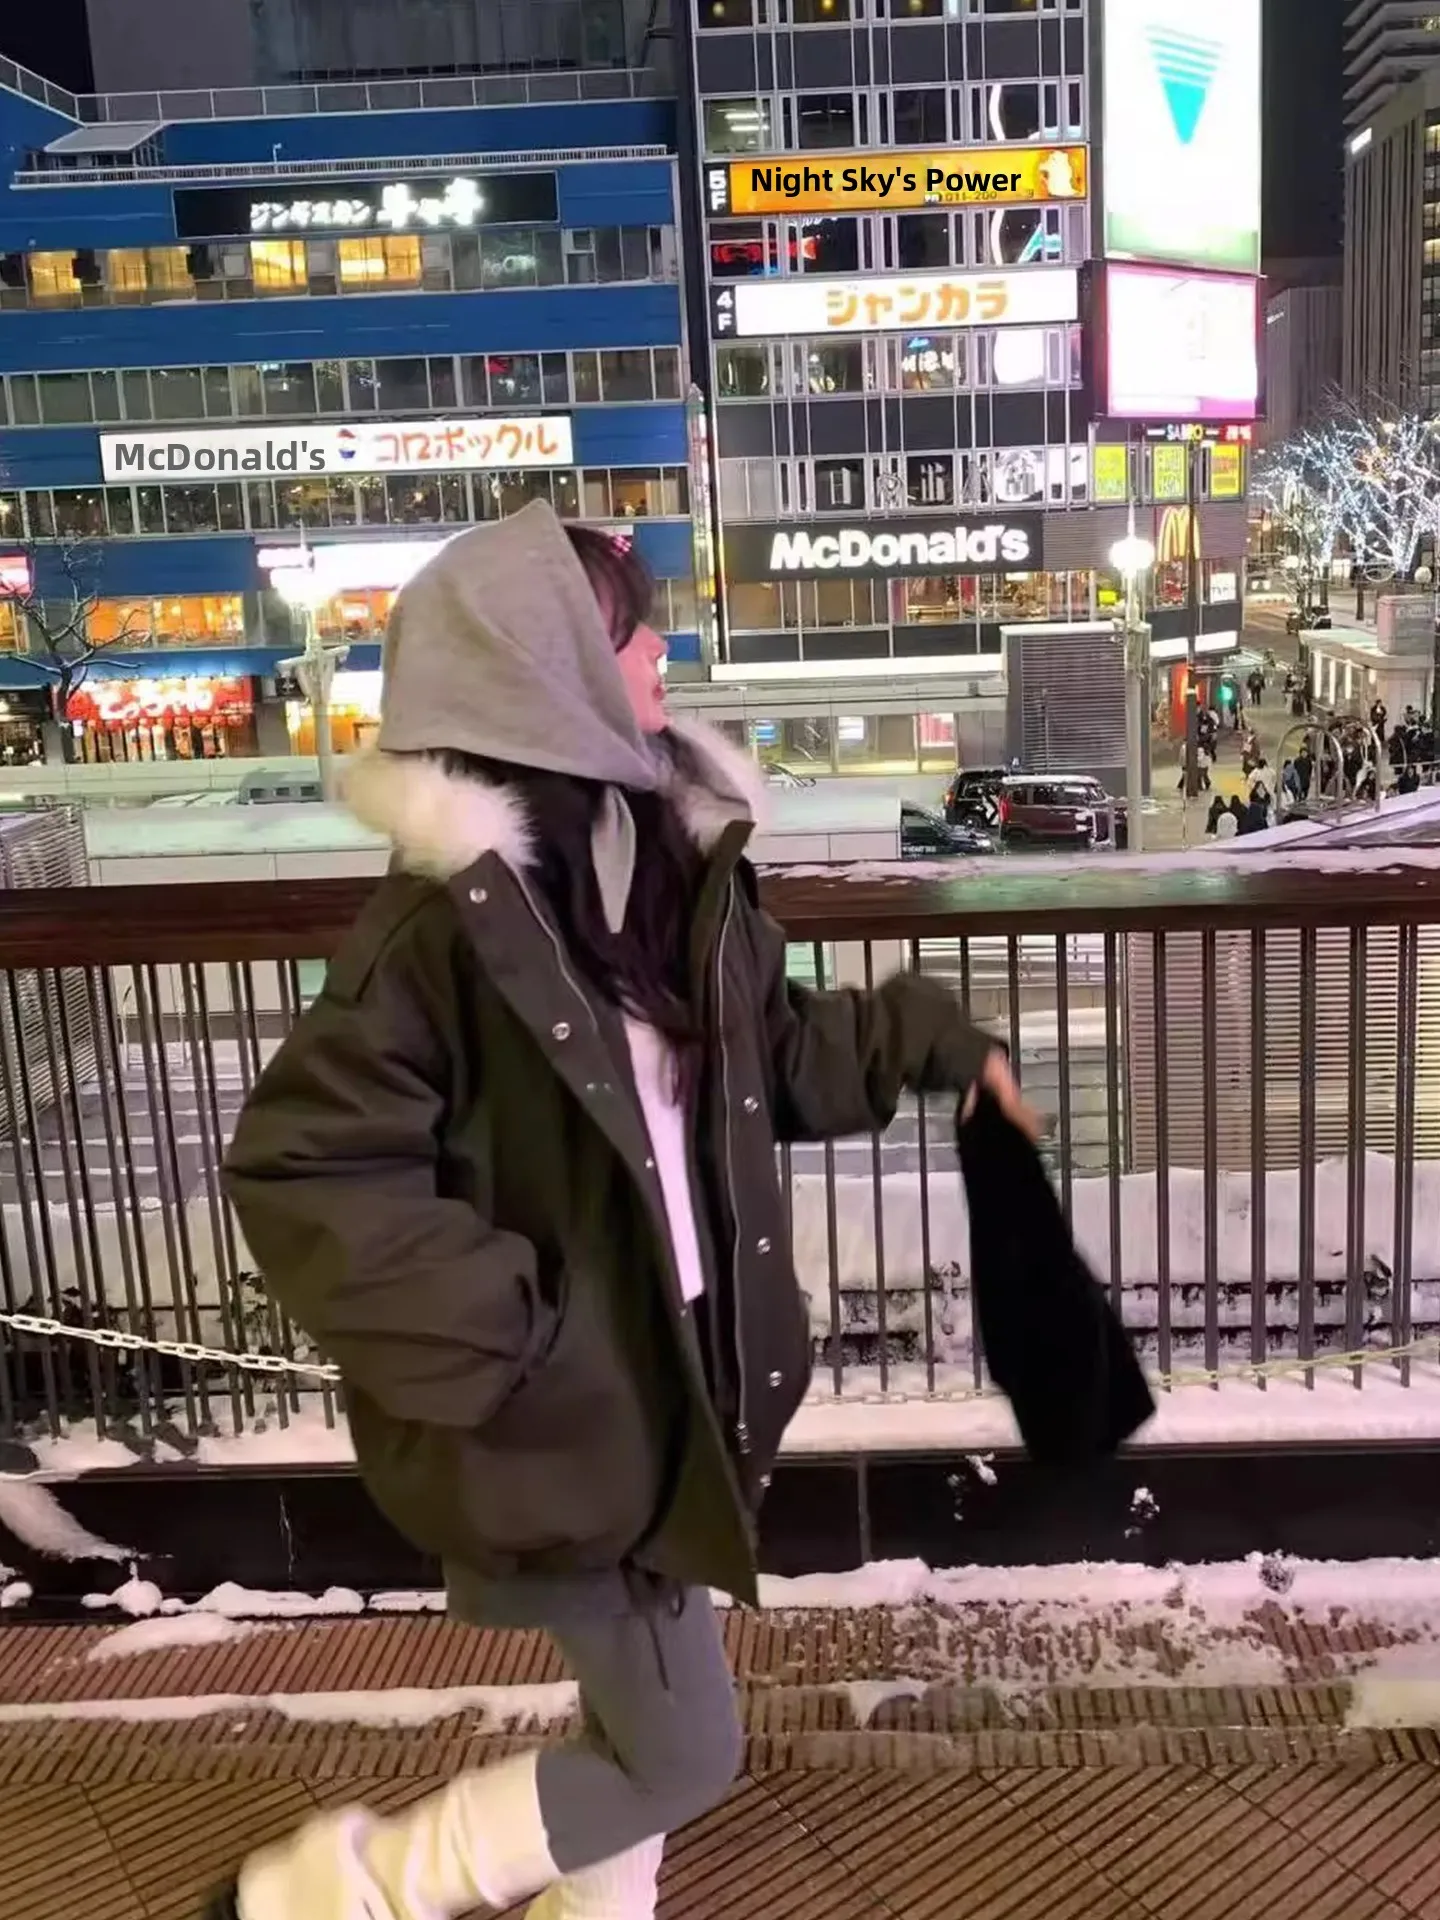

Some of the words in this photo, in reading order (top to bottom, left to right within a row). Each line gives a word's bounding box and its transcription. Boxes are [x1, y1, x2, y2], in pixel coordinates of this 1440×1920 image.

[827, 280, 1009, 328] ジャンカラ
[769, 522, 1030, 571] McDonald's
